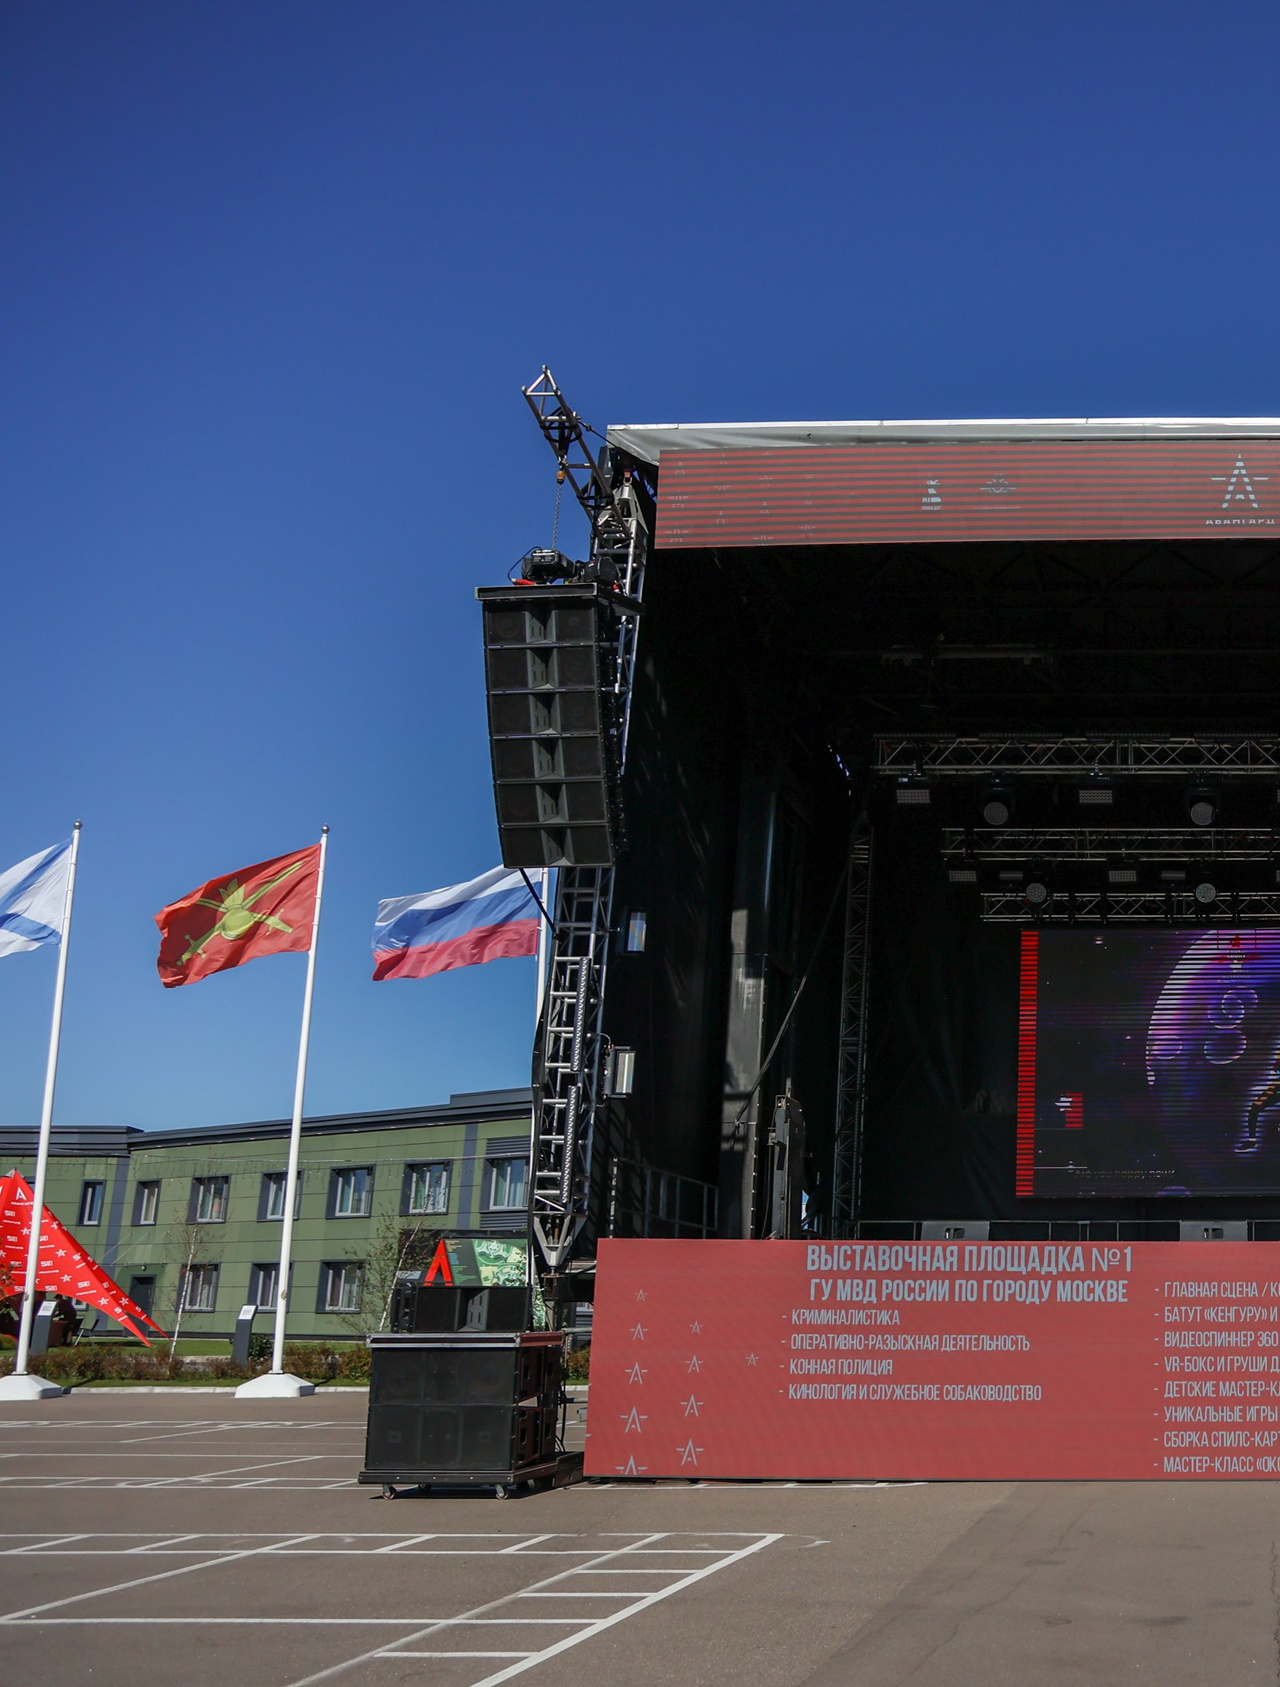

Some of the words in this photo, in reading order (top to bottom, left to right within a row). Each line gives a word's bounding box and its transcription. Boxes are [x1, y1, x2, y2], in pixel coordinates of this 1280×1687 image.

[806, 1244, 959, 1272] ВЫСТАВОЧНАЯ
[964, 1245, 1085, 1275] ПЛОЩАДКА
[810, 1278, 833, 1301] ГУ
[837, 1278, 878, 1304] МВД
[881, 1279, 950, 1302] РОССИИ
[954, 1280, 978, 1302] ПО
[982, 1279, 1052, 1304] ГОРОДУ
[1056, 1280, 1128, 1303] МОСКВЕ
[1164, 1281, 1218, 1298] ГЛАВНАЯ
[1221, 1282, 1259, 1298] СЦЕНА
[791, 1309, 900, 1325] КРИМИНАЛИСТИКА
[1164, 1306, 1202, 1322] БАТУТ
[1269, 1307, 1278, 1321] И
[790, 1334, 939, 1350] ОПЕРАТИВНО-РАЗЫСКНАЯ
[941, 1335, 1030, 1351] ДЕЯТЕЛЬНОСТЬ
[1164, 1331, 1255, 1347] ВИДЕОСПИННЕР
[1257, 1331, 1279, 1347] 360
[789, 1359, 836, 1374] КОННАЯ
[838, 1359, 893, 1375] ПОЛИЦИЯ
[1164, 1356, 1214, 1372] VR-БОКС
[1216, 1357, 1225, 1371] И
[1226, 1356, 1268, 1372] ГРУШИ
[788, 1384, 857, 1399] КИНОЛОГИЯ
[858, 1385, 868, 1400] И
[869, 1384, 940, 1400] СЛУЖЕБНОЕ
[943, 1385, 1042, 1401] СОБАКОВОДСТВО
[1164, 1381, 1216, 1397] ДЕТСКИЕ
[1164, 1406, 1243, 1422] УНИКАЛЬНЫЕ
[1246, 1406, 1278, 1421] ИГРЫ
[1164, 1431, 1209, 1448] СБОРКА
[1164, 1456, 1254, 1472] МАСТЕР-КЛАСС
